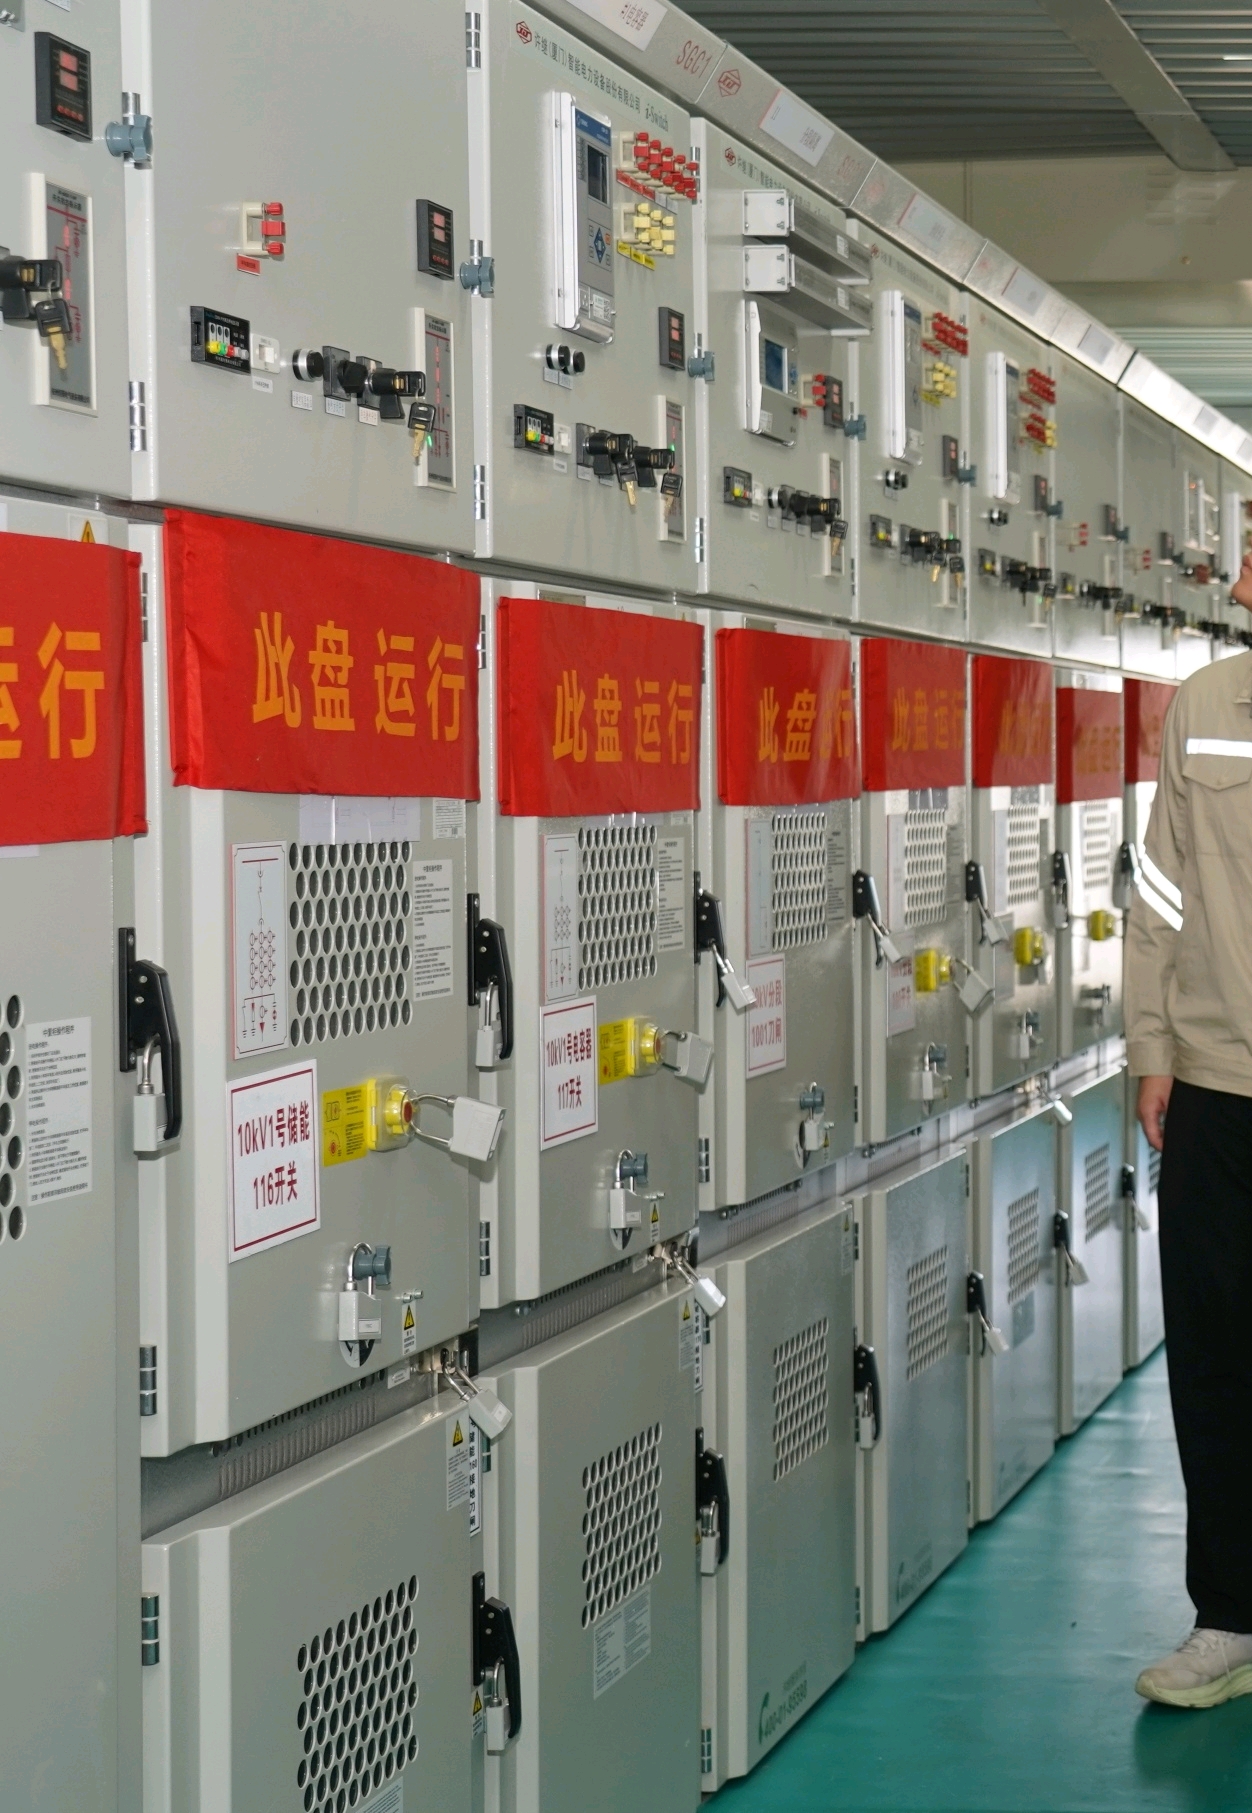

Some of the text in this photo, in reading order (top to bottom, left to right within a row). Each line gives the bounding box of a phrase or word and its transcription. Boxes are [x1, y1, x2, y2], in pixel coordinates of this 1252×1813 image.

[676, 39, 712, 78] SGC1
[645, 103, 669, 132] i-Switch
[252, 611, 466, 742] 此盘运行
[552, 669, 694, 765] 此盘运行
[546, 1027, 593, 1068] 10kV1号电容器
[752, 1017, 782, 1048] 1001刀闸
[558, 1075, 582, 1110] 117开关
[237, 1100, 311, 1157] 10kV1号储能
[253, 1160, 298, 1210] 116开关
